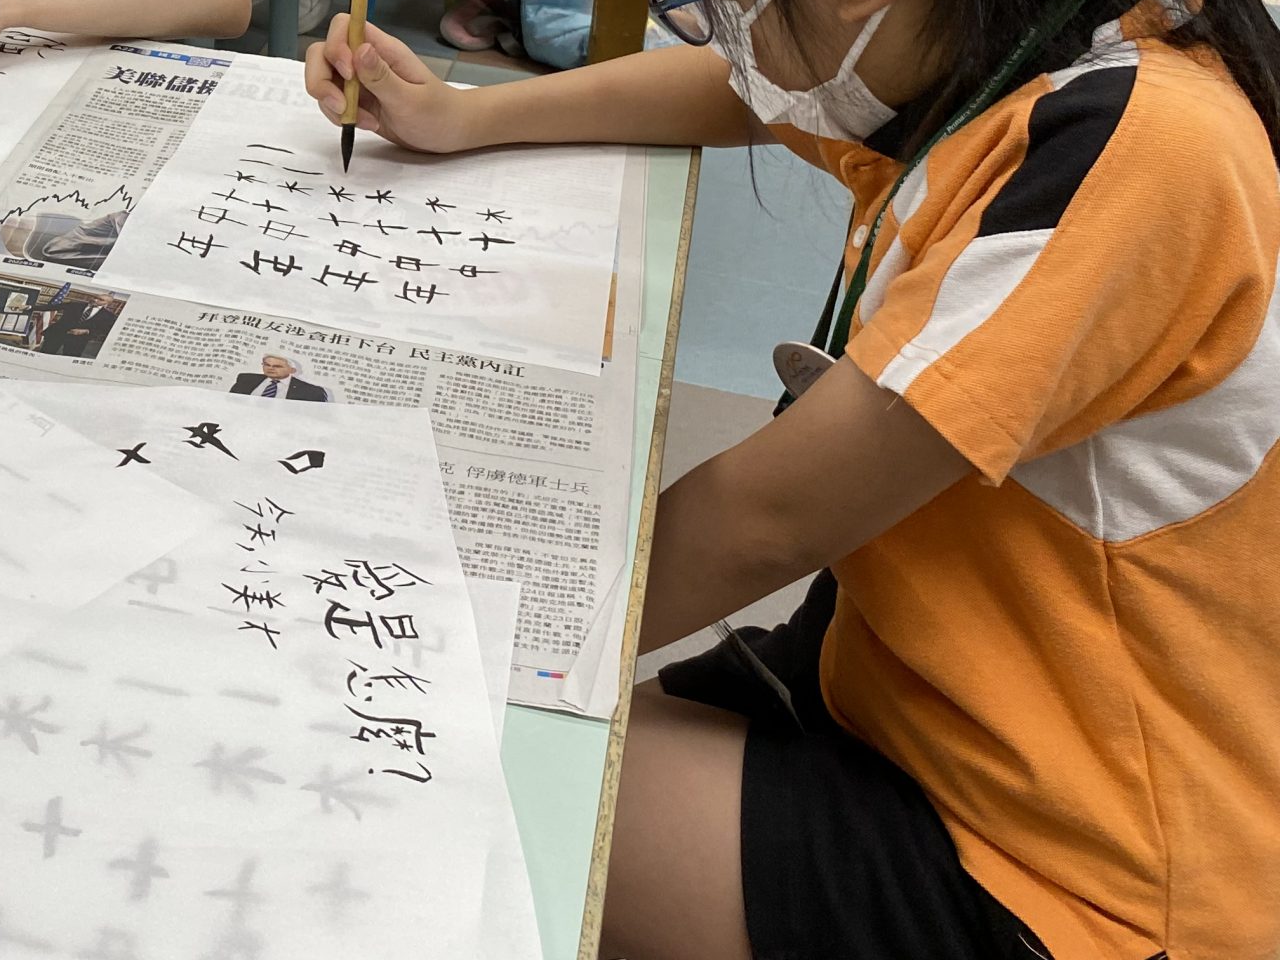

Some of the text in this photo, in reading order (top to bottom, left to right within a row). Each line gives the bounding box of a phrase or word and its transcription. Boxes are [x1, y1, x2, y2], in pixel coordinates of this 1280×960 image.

[198, 310, 397, 356] 拜登盟友涉貪拒下台
[409, 346, 526, 379] 民主黨內訌
[465, 464, 594, 496] 俘虜德軍士兵
